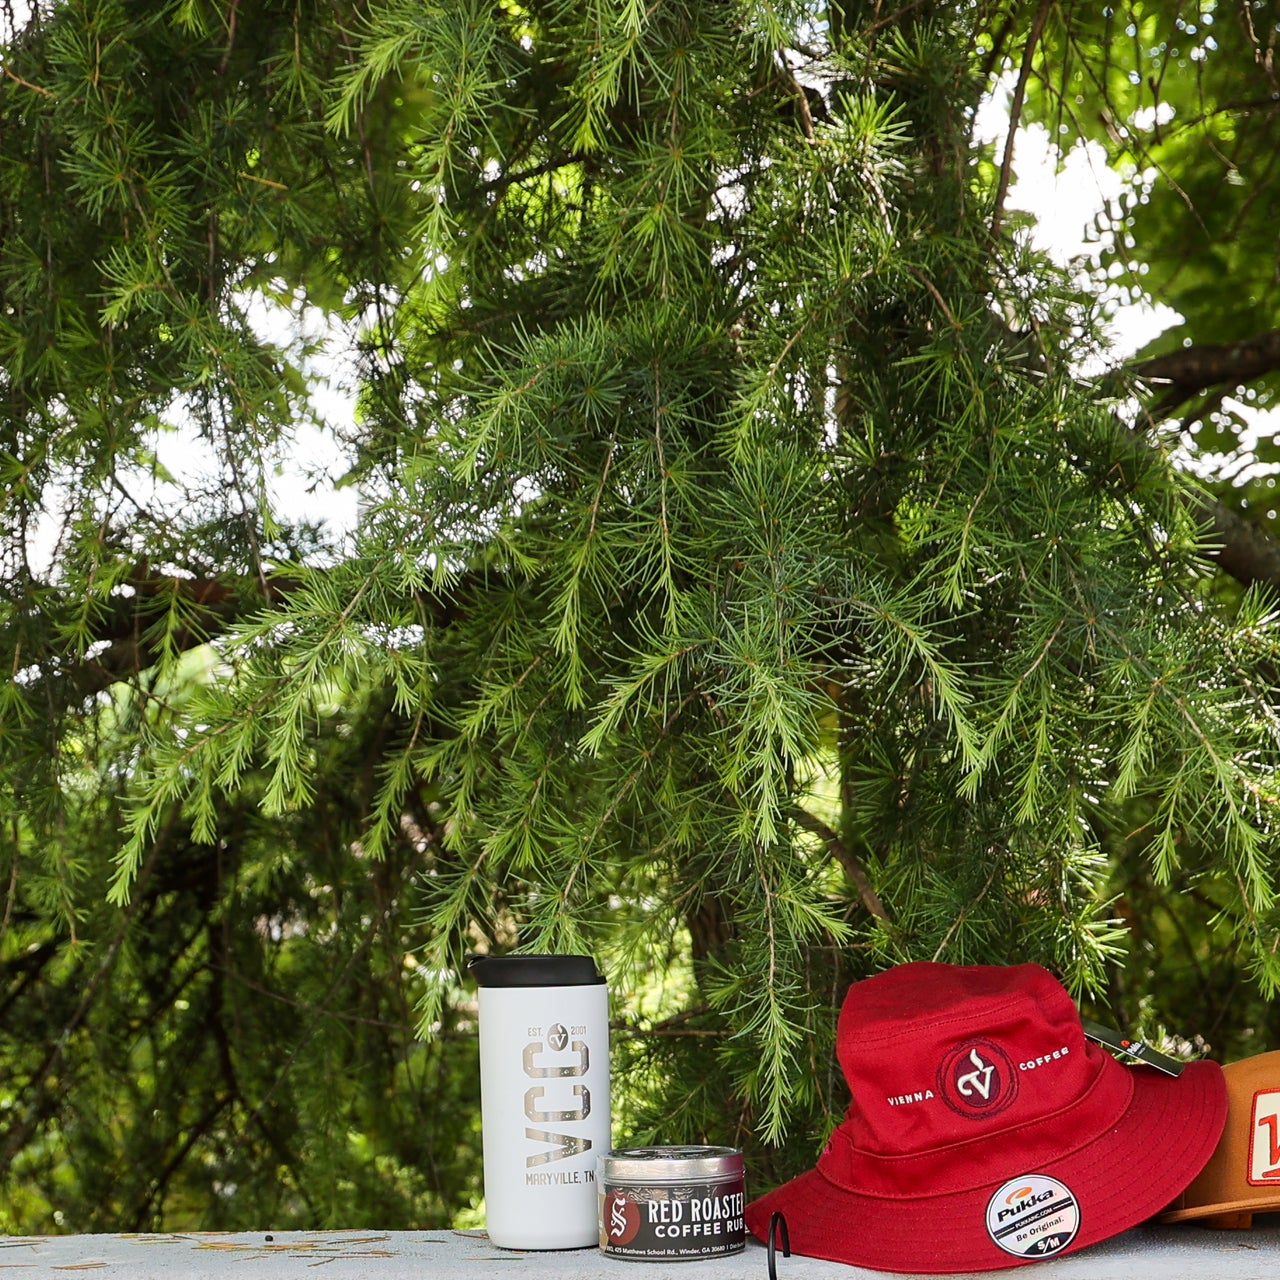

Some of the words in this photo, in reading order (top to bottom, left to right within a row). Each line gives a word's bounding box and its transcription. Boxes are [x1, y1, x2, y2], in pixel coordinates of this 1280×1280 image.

[527, 1027, 544, 1037] EST.
[570, 1025, 587, 1036] 2001
[1019, 1046, 1069, 1071] COFFEE
[522, 1040, 593, 1168] VCC
[887, 1089, 934, 1106] VIENNA
[525, 1171, 582, 1186] MARYVILLE,
[583, 1170, 595, 1183] TN
[648, 1199, 683, 1224] RED
[997, 1190, 1054, 1223] Pukka
[654, 1223, 721, 1238] COFFEE
[726, 1217, 744, 1234] RUB
[1016, 1232, 1028, 1242] Be
[1037, 1237, 1060, 1254] S/M
